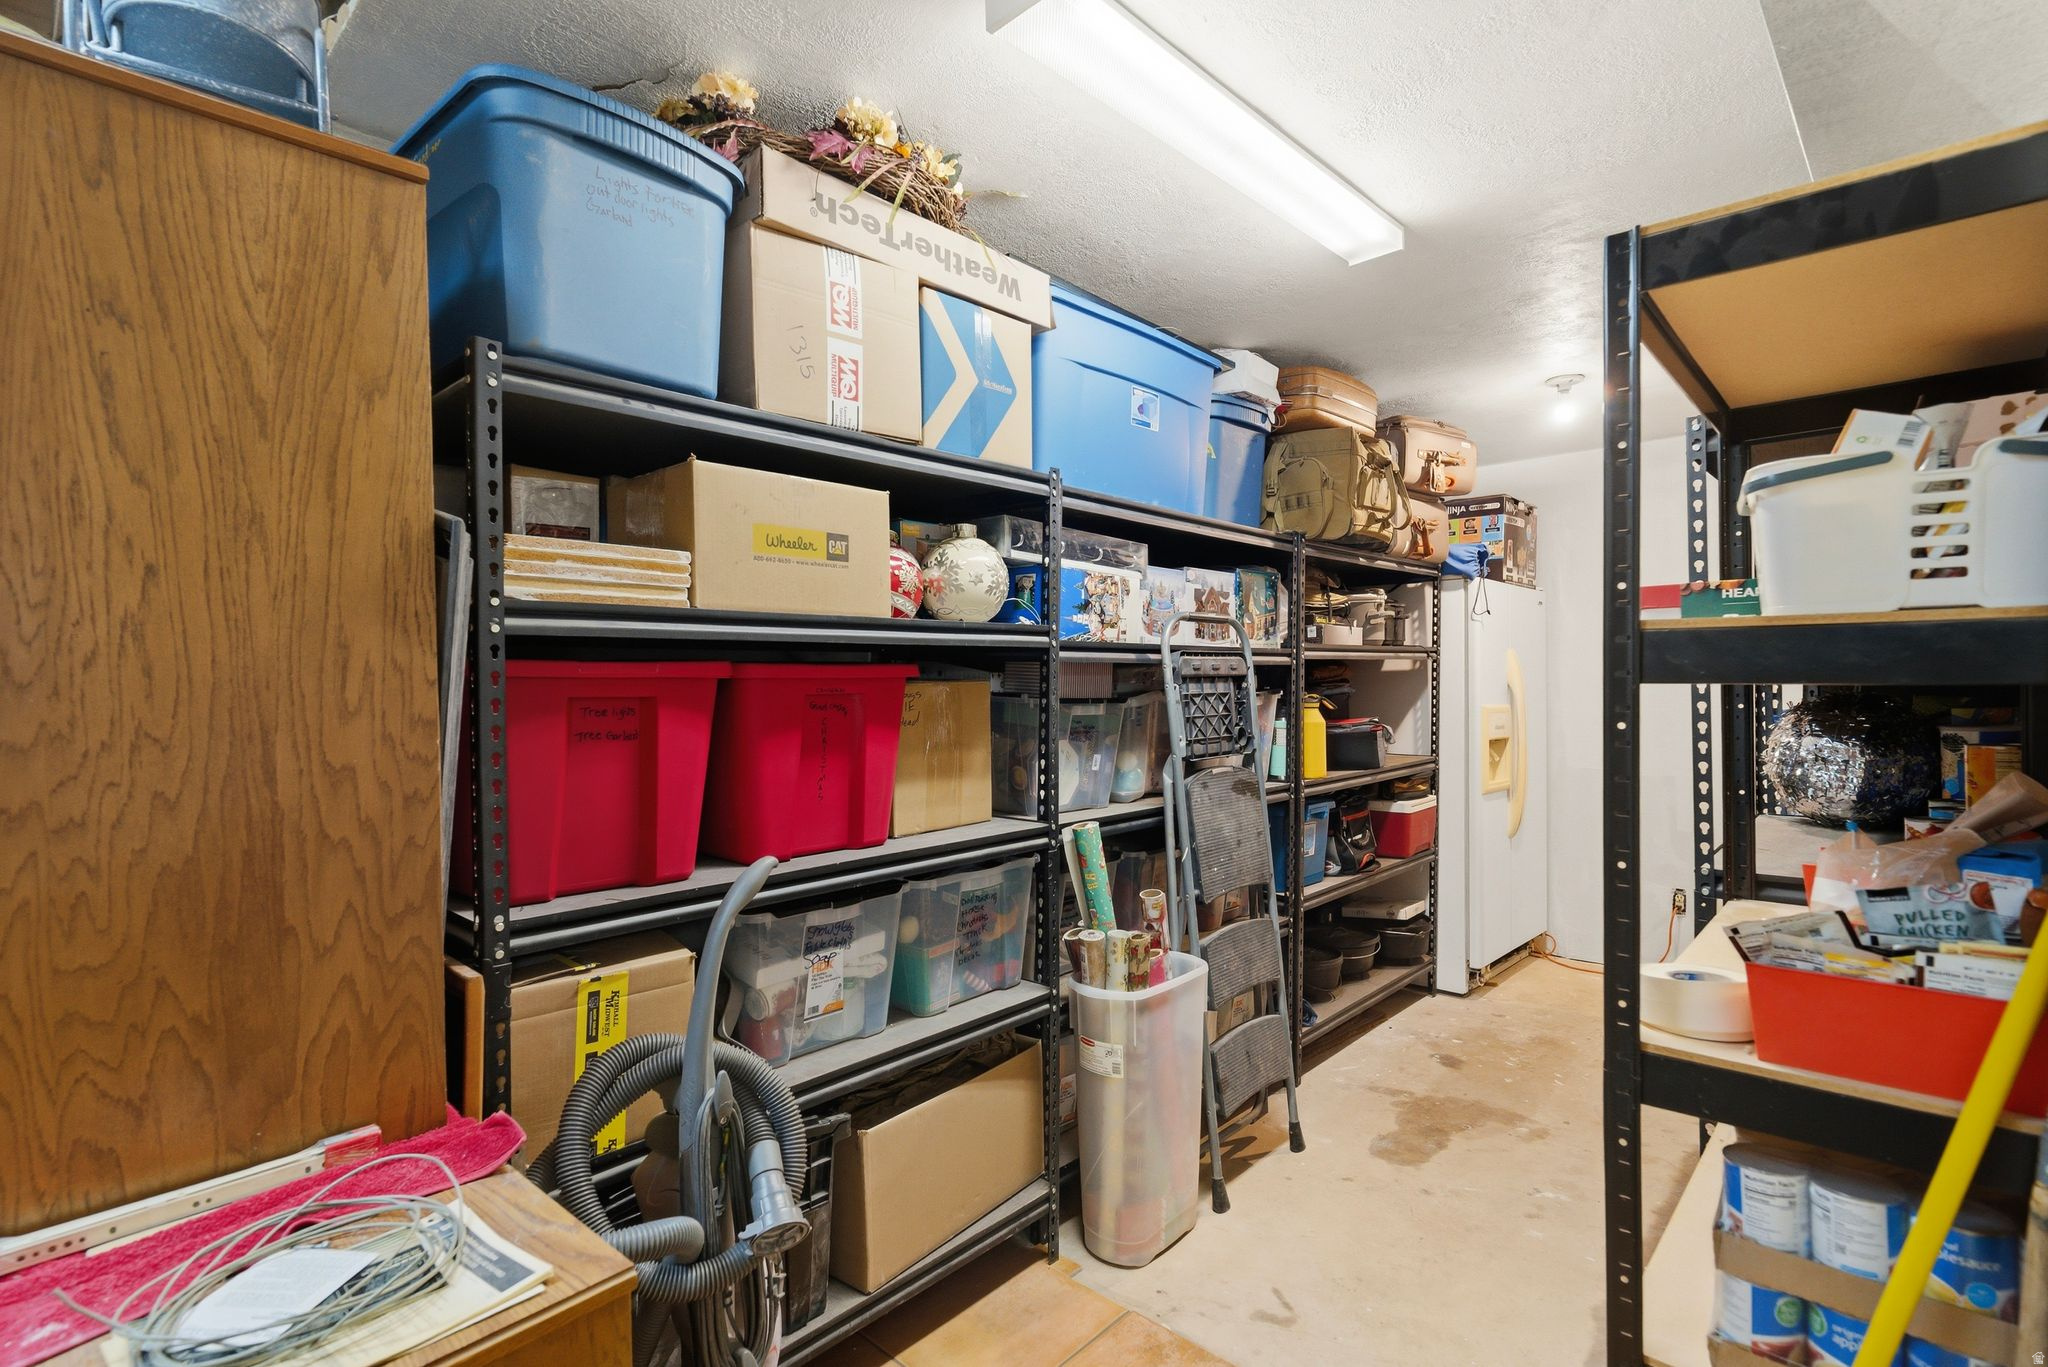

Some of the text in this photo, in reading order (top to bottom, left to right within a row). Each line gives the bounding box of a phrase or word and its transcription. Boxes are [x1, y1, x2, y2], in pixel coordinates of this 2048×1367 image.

[815, 191, 1022, 302] WeatherTech
[765, 533, 848, 556] Wheeler CAT
[579, 706, 608, 718] Tree
[573, 730, 602, 743] Tree
[1893, 909, 1965, 925] PULLED
[1897, 924, 1970, 940] CHICKEN
[803, 951, 837, 970] Soap
